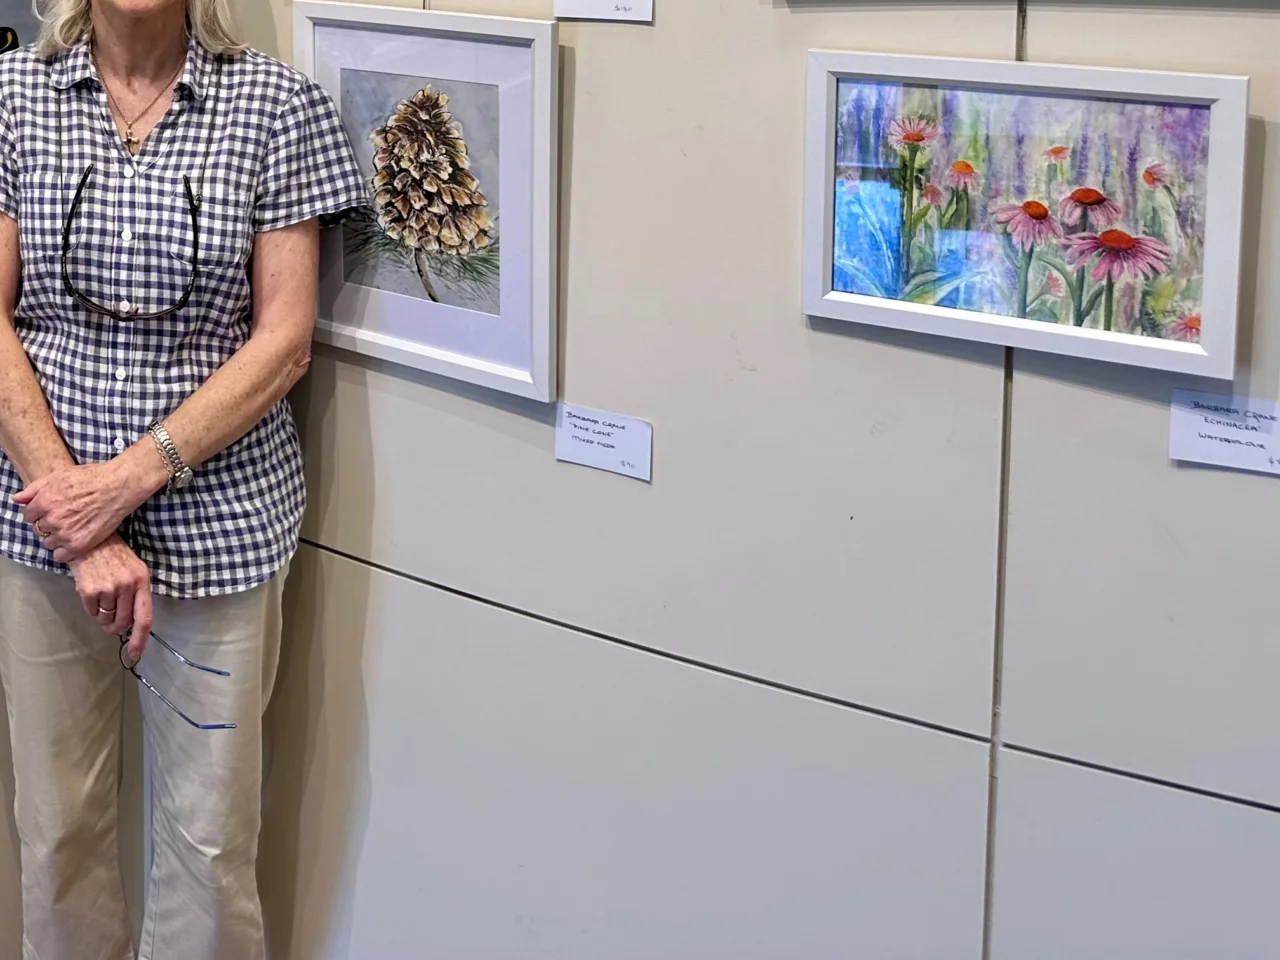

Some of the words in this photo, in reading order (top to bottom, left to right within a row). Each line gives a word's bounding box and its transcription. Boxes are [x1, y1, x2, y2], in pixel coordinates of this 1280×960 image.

[566, 411, 599, 425] BARBARA
[602, 421, 626, 430] CRANE
[1191, 400, 1239, 414] BARBARA
[1244, 410, 1278, 423] CRANE
[572, 435, 594, 444] MIXED
[597, 441, 615, 449] MEDIA
[1198, 432, 1266, 450] WATERCOLOUR
